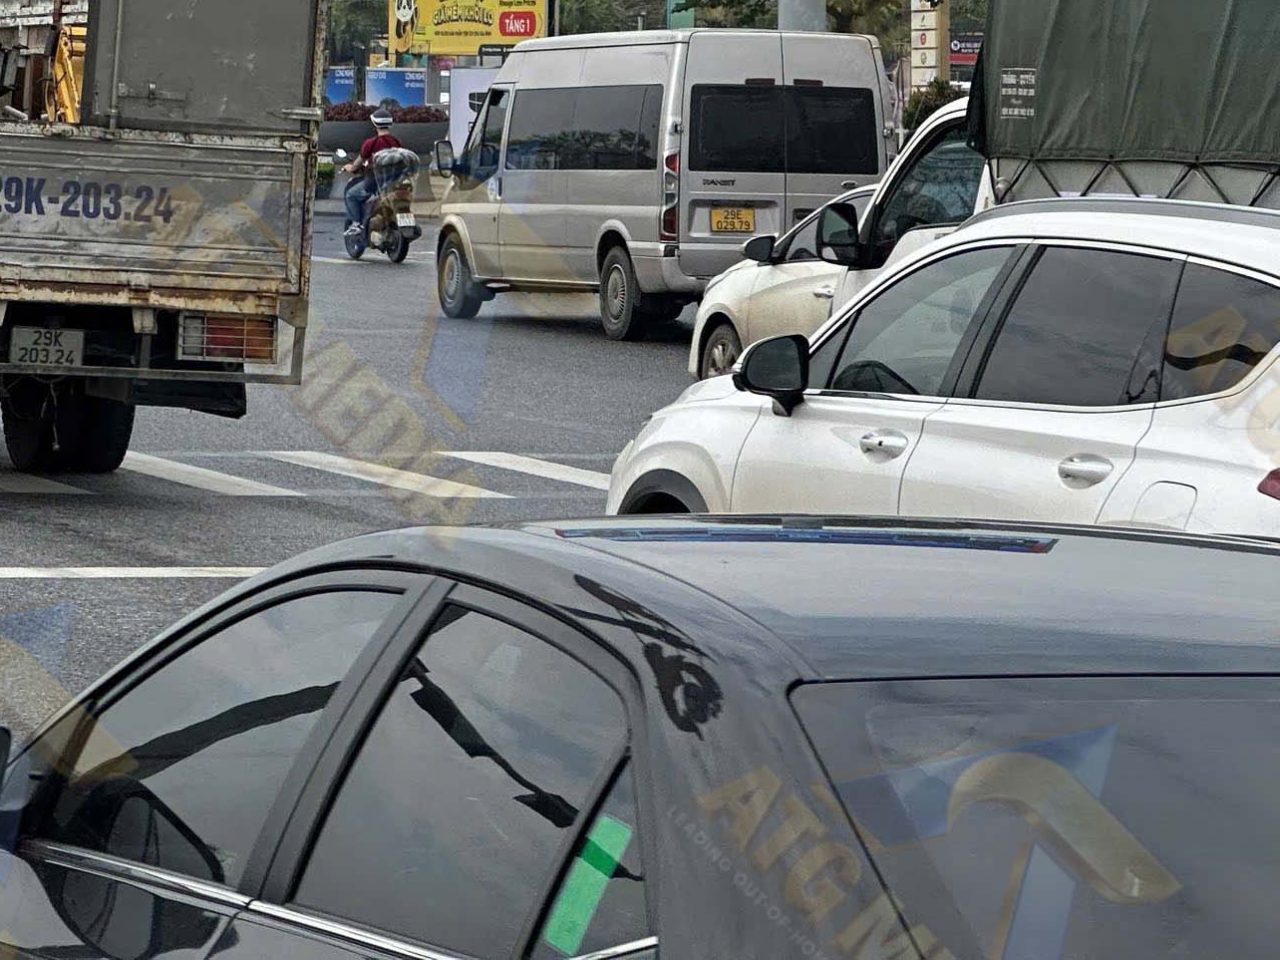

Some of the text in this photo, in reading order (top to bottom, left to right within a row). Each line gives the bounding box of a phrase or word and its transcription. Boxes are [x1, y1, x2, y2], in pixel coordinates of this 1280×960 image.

[723, 209, 743, 220] 29E
[716, 220, 750, 230] 029.79
[33, 330, 64, 347] 29K
[18, 347, 75, 365] 203.24
